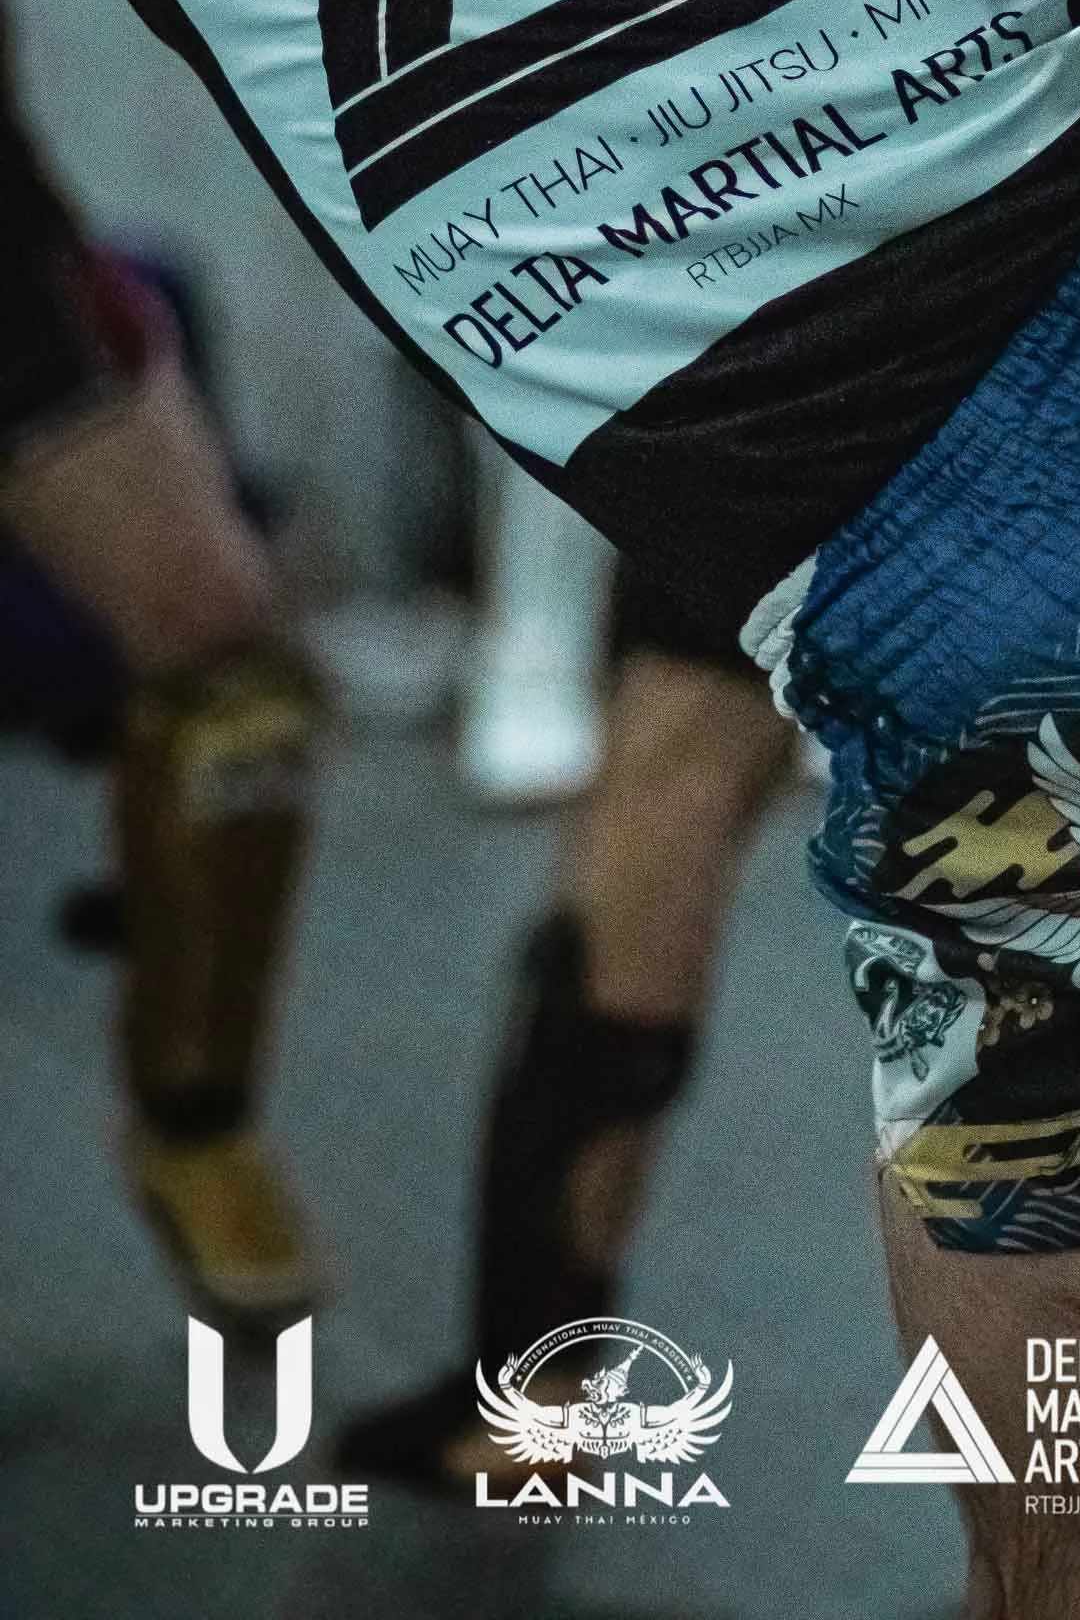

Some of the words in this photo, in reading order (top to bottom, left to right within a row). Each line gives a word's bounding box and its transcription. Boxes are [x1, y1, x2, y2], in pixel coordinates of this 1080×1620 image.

[393, 197, 500, 296] MUAY
[500, 135, 624, 218] THAI
[647, 85, 713, 147] JIU
[717, 28, 840, 114] JITSU
[442, 251, 611, 370] DELTA
[597, 102, 888, 259] MARTIAL
[890, 10, 1033, 125] ARTS
[685, 222, 800, 289] RTBJJA
[796, 183, 861, 231] MX
